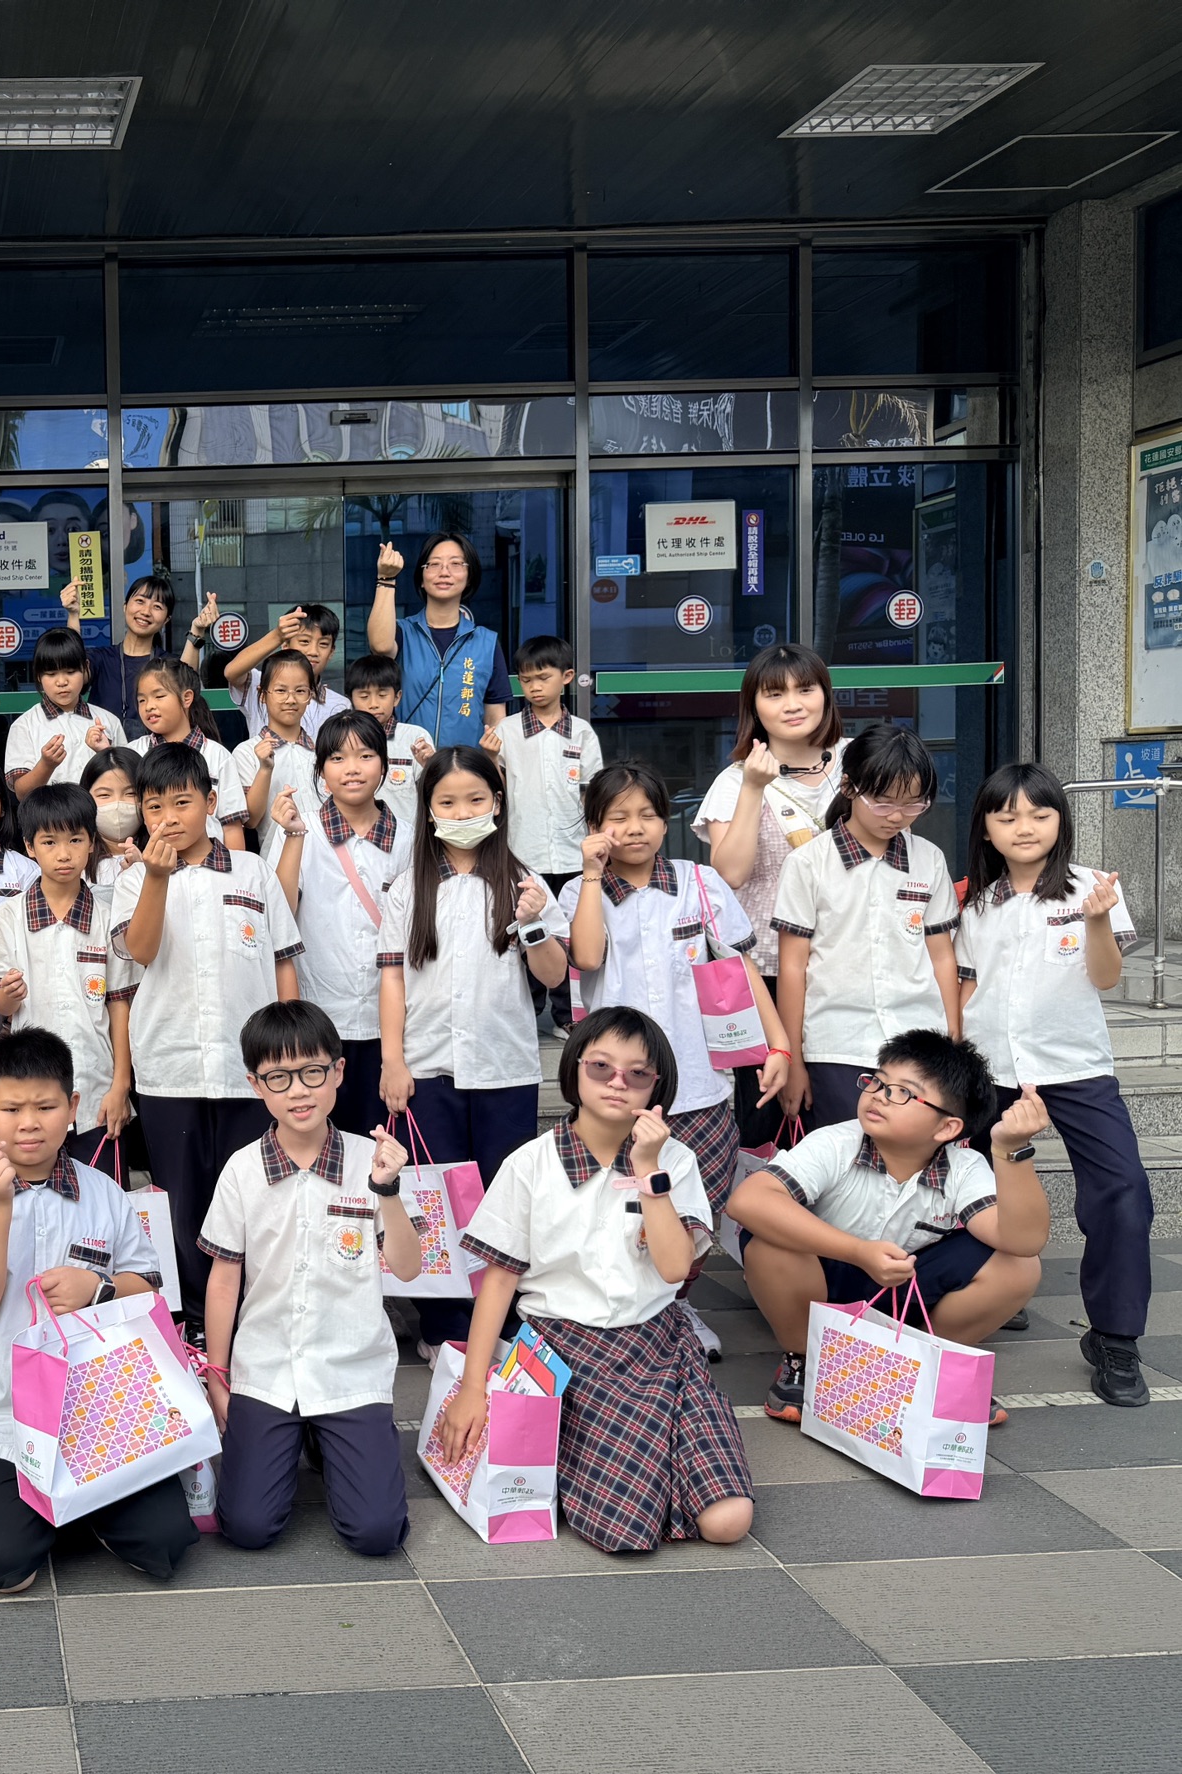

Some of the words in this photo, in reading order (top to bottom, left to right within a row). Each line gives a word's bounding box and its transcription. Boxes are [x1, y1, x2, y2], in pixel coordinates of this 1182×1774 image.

[673, 516, 710, 525] DHL
[656, 536, 725, 549] 代理收件處
[747, 526, 759, 593] 請脫安全帽再進入
[12, 574, 24, 583] Ship
[25, 573, 43, 581] Center
[683, 603, 705, 626] 郵
[894, 598, 916, 621] 郵
[218, 621, 241, 643] 郵
[458, 657, 476, 718] 花蓮郵局
[1141, 747, 1161, 761] 坡道
[339, 1196, 367, 1205] 111093
